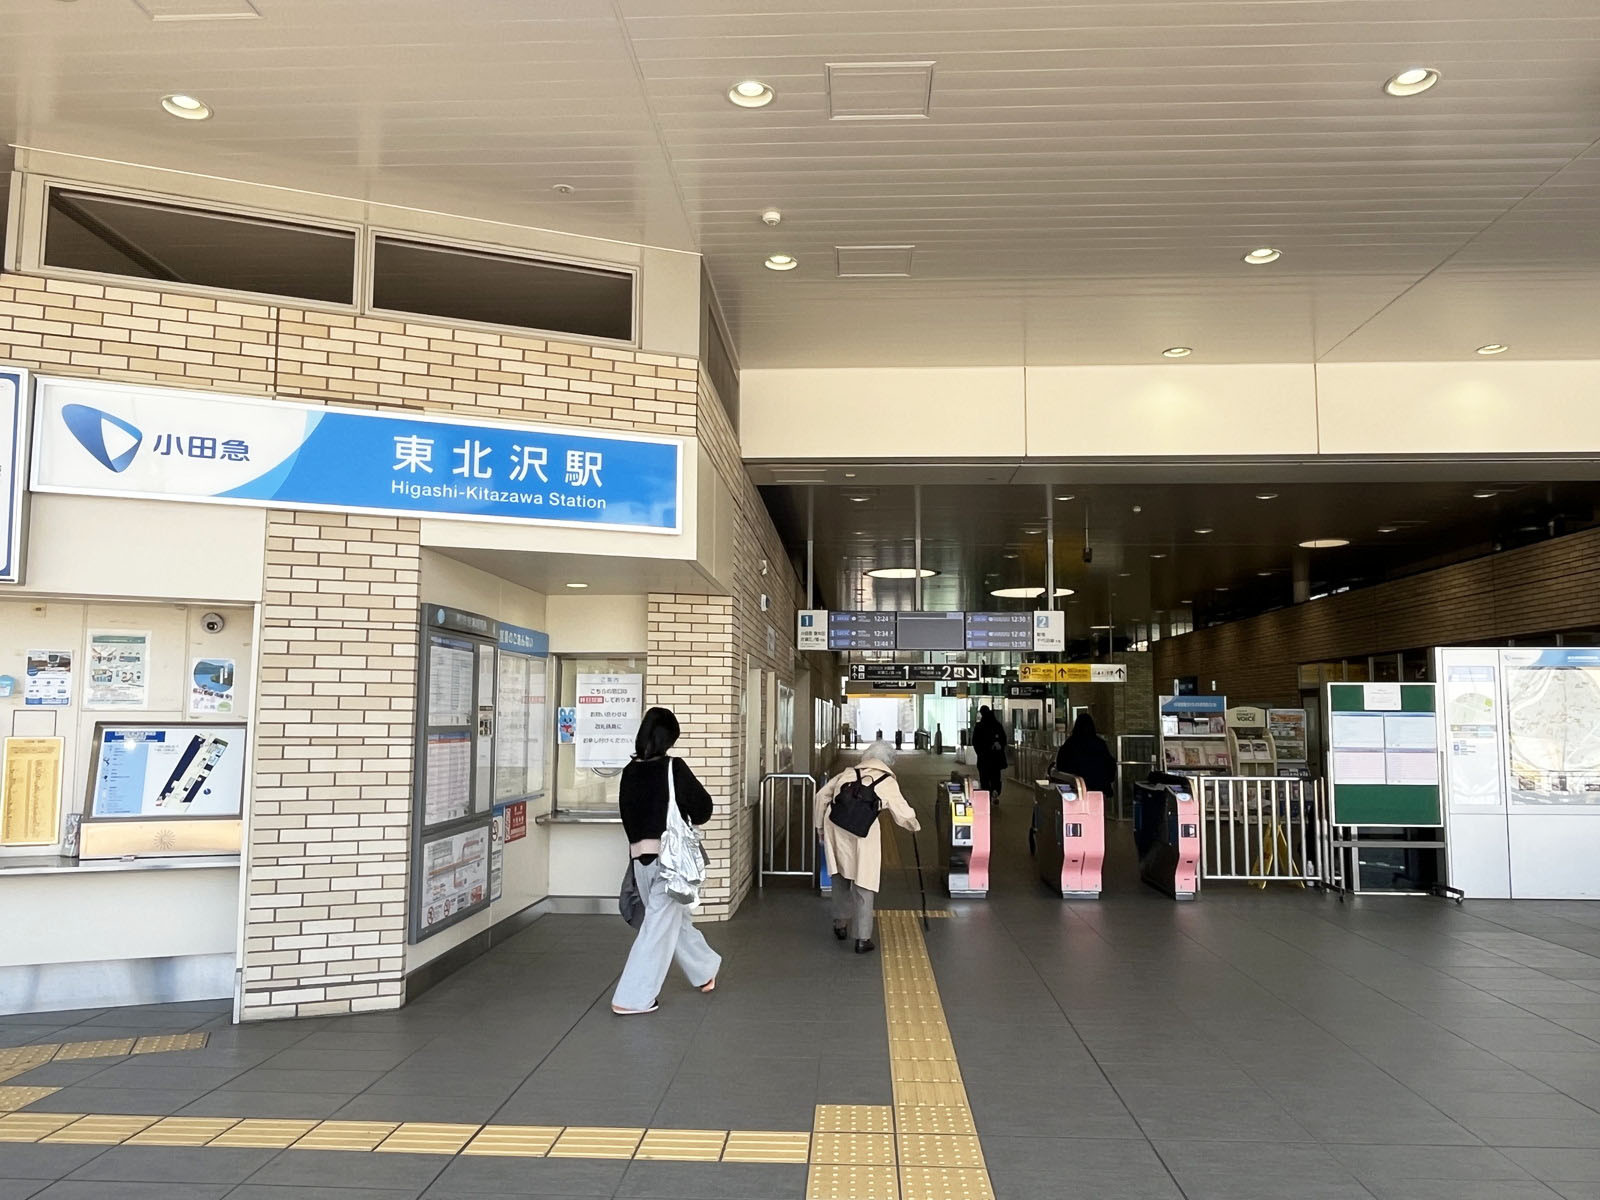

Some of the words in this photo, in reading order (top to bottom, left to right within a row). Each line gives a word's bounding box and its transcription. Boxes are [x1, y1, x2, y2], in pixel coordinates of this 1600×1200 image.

[153, 433, 251, 462] 小田急
[392, 434, 603, 488] 東北沢駅
[391, 480, 543, 505] Higashi-Kitazawa
[549, 492, 606, 509] Station
[1039, 616, 1047, 628] 2
[902, 665, 910, 680] 1
[941, 665, 952, 680] 2
